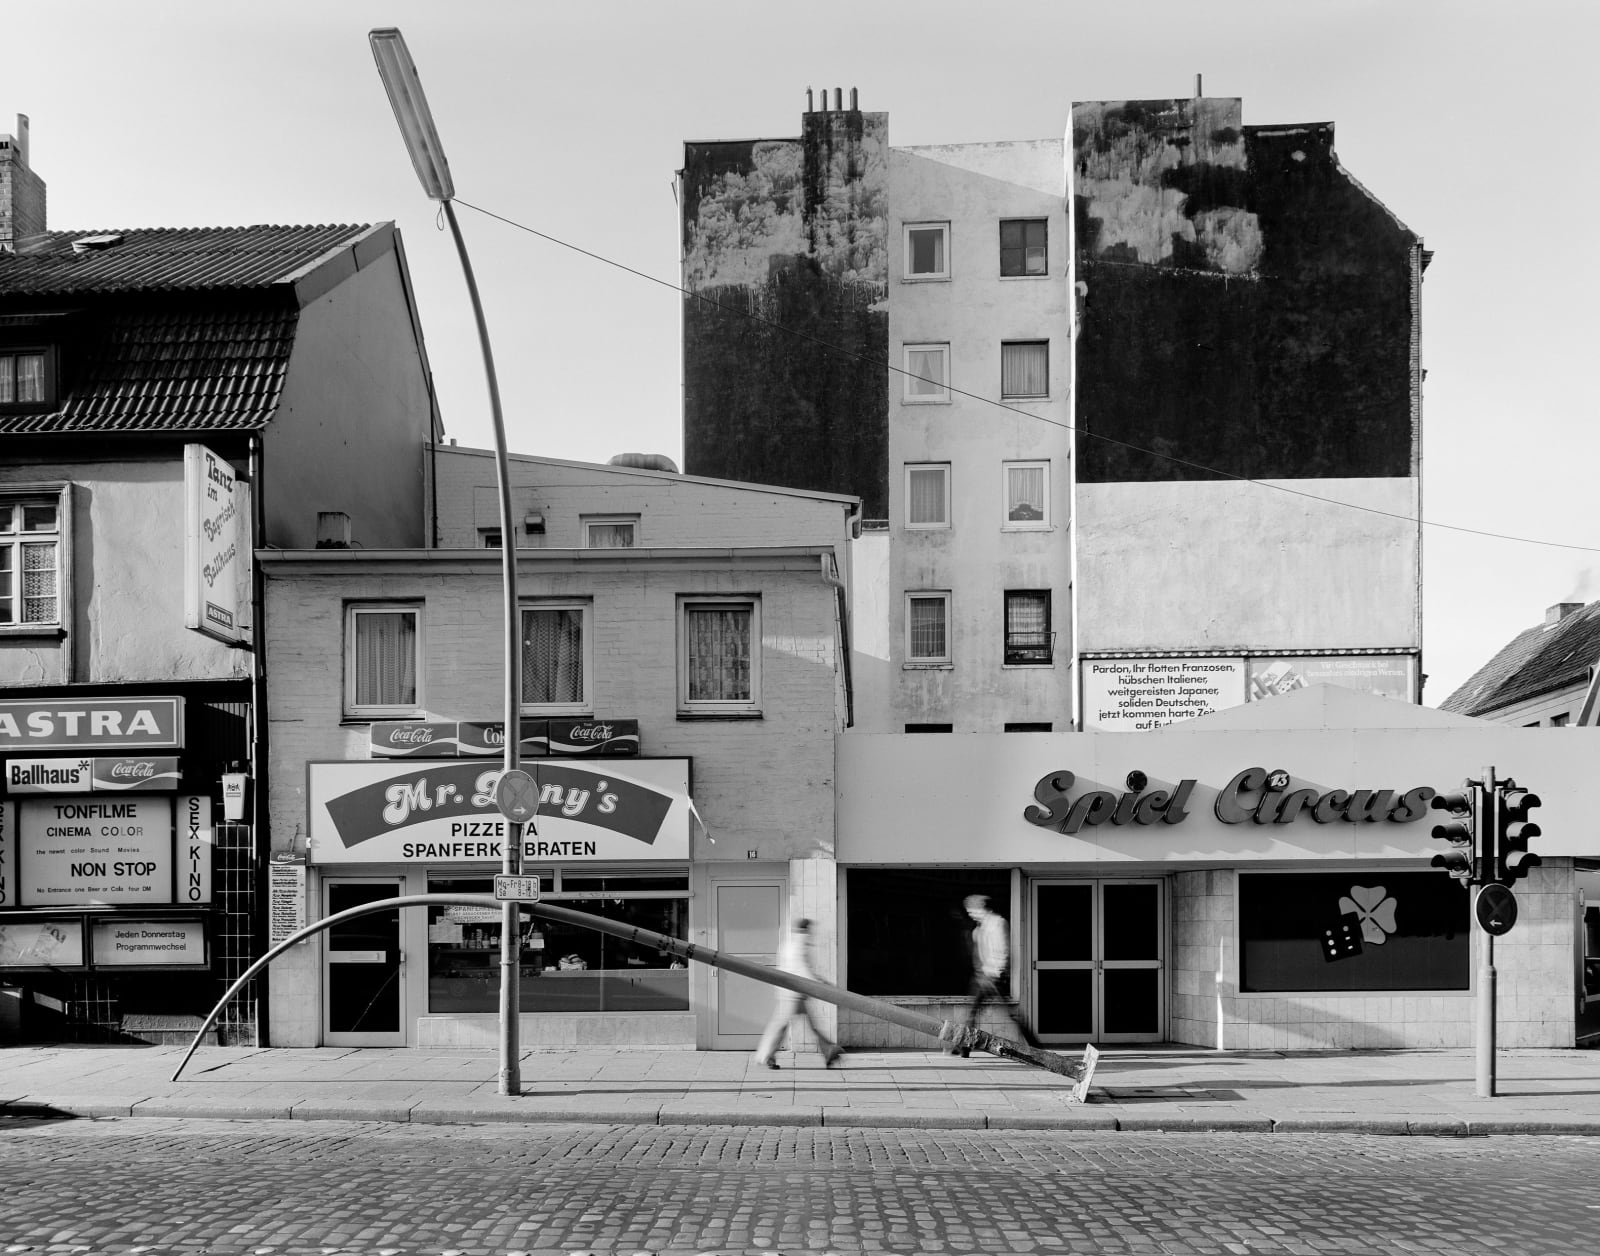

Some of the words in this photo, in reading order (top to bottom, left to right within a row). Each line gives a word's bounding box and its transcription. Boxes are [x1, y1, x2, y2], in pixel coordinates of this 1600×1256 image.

[206, 452, 233, 492] Tanz
[207, 483, 218, 502] im
[203, 542, 236, 588] Ballhaus
[208, 606, 232, 625] ASTRA
[1092, 664, 1132, 675] Pardon,
[1132, 664, 1146, 673] Ihr
[1148, 664, 1180, 673] flotten
[1182, 663, 1236, 673] Franzosen,
[1118, 674, 1165, 685] hübschen
[1167, 674, 1208, 685] Italiener,
[1107, 687, 1176, 698] weitgereisten
[1178, 686, 1219, 698] Japaner,
[1118, 698, 1153, 708] soliden
[1155, 697, 1209, 708] Deutschen,
[1098, 709, 1120, 721] jetzt
[1122, 708, 1166, 719] kommen
[1168, 708, 1195, 718] harte
[0, 710, 160, 738] ASTRA
[1135, 720, 1153, 730] auf
[390, 728, 434, 743] Coca-Cola
[570, 725, 614, 740] Coca-Cola
[112, 762, 155, 778] Coca-Cola
[1270, 774, 1289, 787] 13
[382, 777, 464, 826] Mr.
[1023, 769, 1198, 834] Spiel
[1213, 766, 1436, 826] Circus
[54, 804, 136, 819] TONFILME
[188, 797, 200, 840] SEX
[46, 827, 92, 837] CINEMA
[101, 826, 143, 836] COLOR
[451, 822, 538, 838] PIZZEA
[402, 841, 596, 858] SPANFERKBRATEN
[71, 862, 106, 877] NON
[113, 862, 156, 876] STOP
[188, 846, 201, 901] KINO
[115, 930, 140, 938] Jeden
[141, 930, 186, 940] Donnerstag
[116, 942, 186, 952] Programmwechsel
